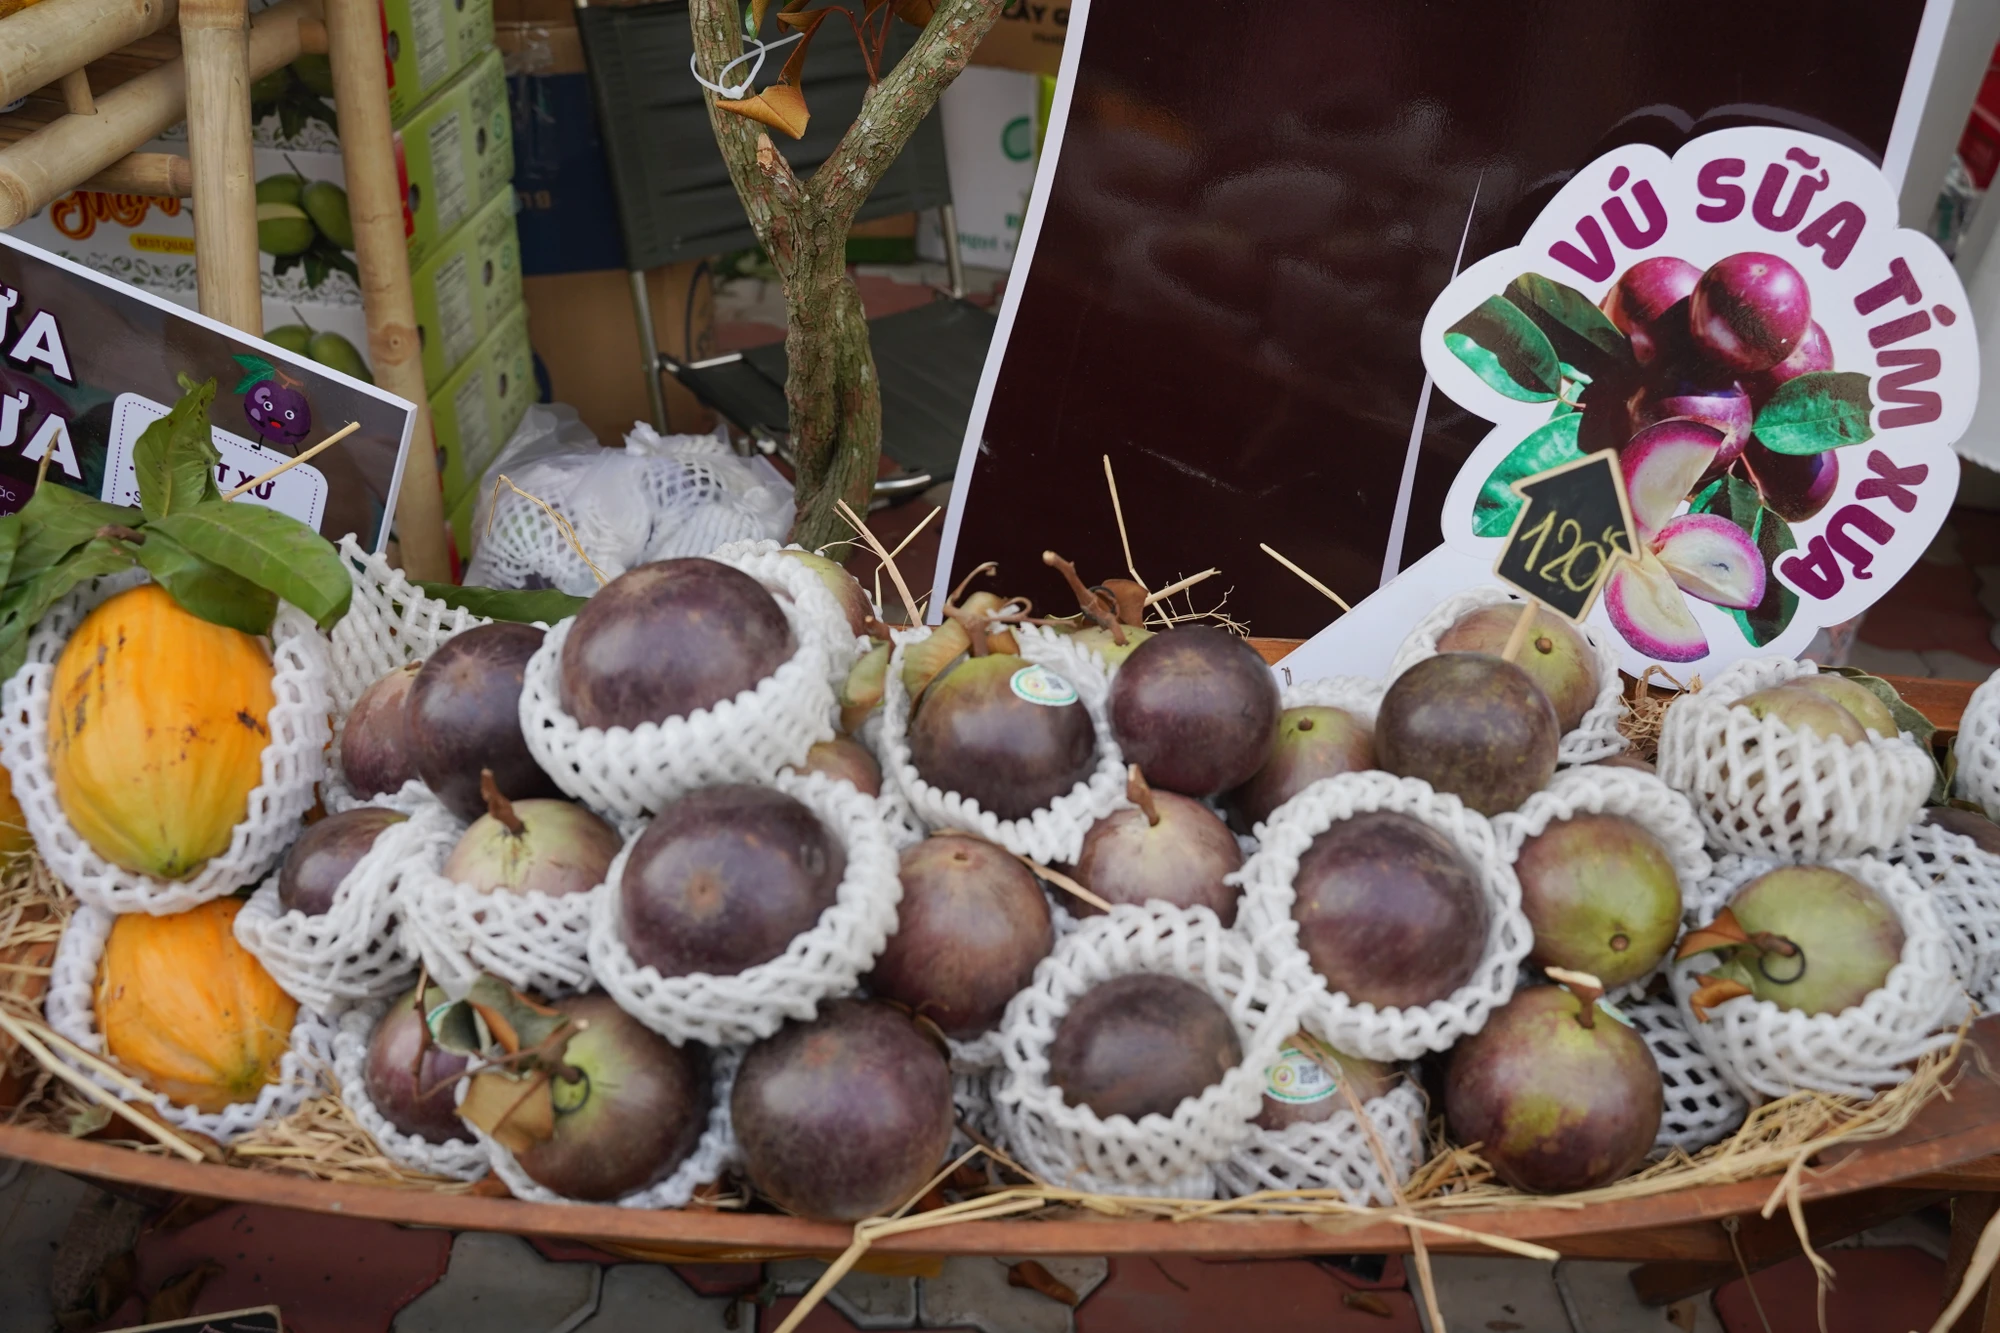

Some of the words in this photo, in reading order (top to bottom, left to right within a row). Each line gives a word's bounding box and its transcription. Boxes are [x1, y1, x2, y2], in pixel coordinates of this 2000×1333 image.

[1548, 165, 1668, 283] VÚ
[1696, 146, 1867, 270] SỮA
[1854, 256, 1956, 430] TÍM
[1779, 449, 1929, 600] XƯA
